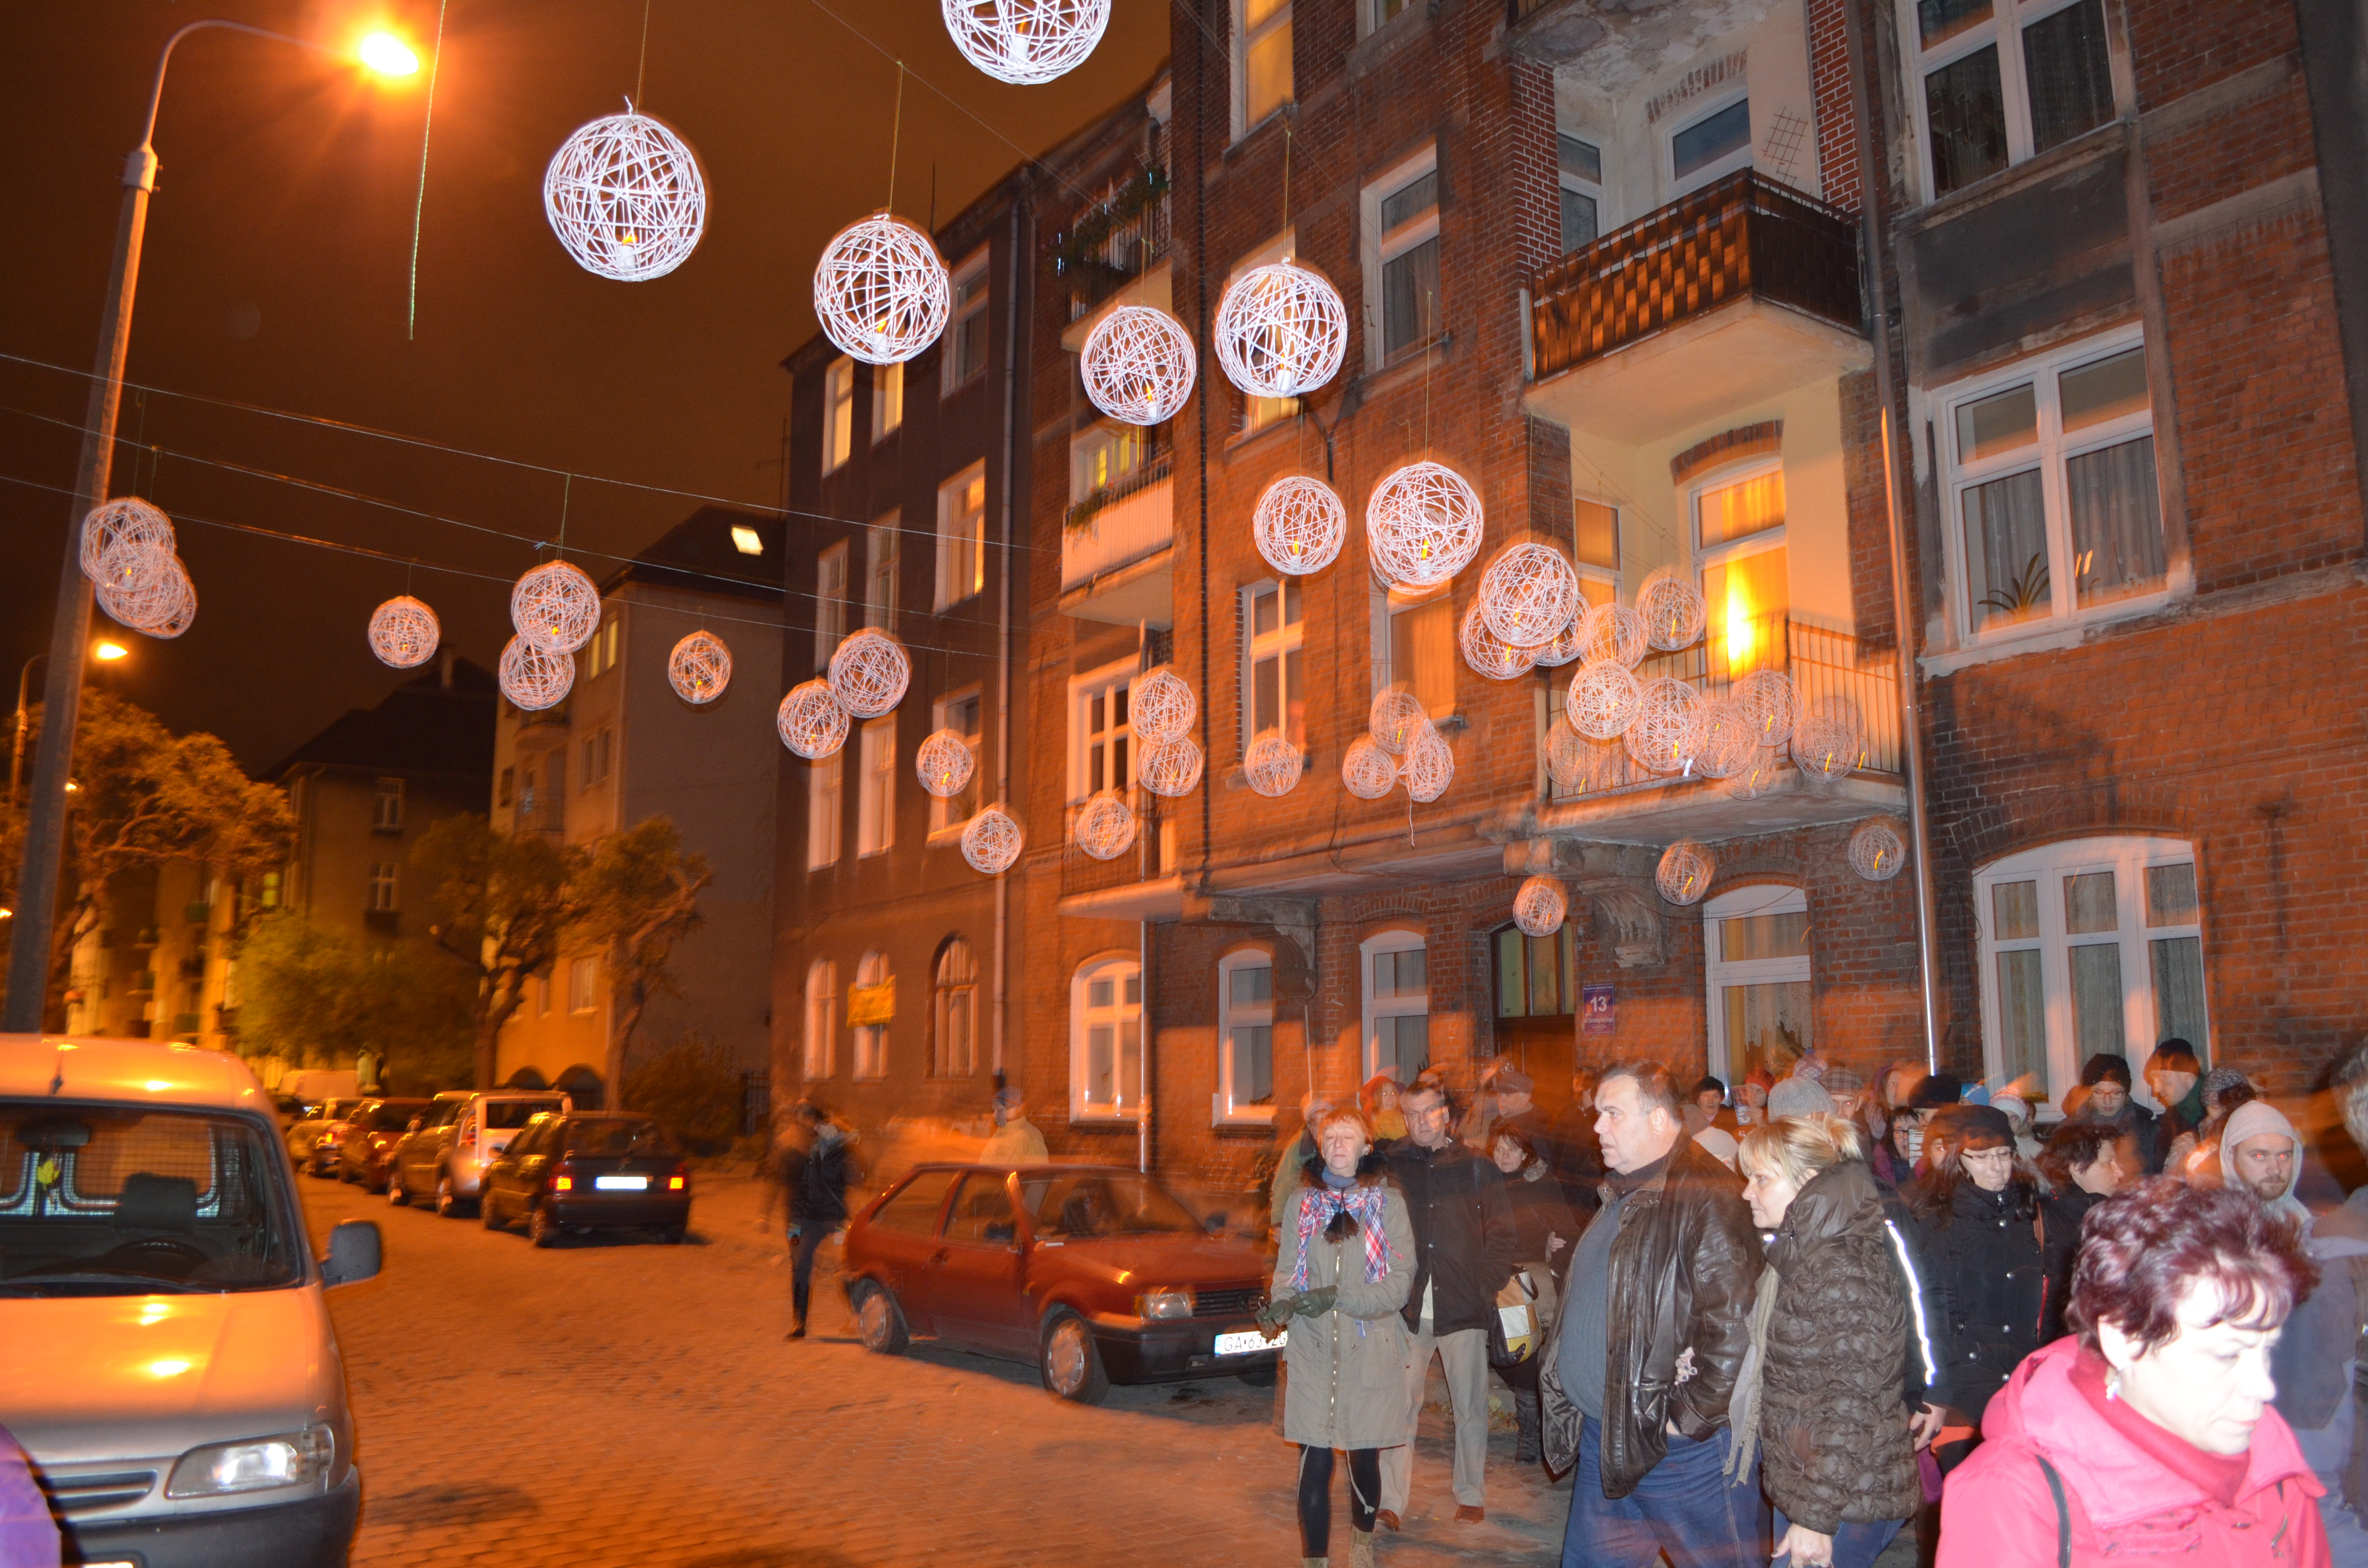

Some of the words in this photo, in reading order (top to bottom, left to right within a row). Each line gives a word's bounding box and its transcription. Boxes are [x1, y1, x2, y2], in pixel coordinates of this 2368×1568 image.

[1591, 996, 1607, 1012] 13
[1224, 1335, 1242, 1351] GA
[1248, 1332, 1286, 1349] 632G
